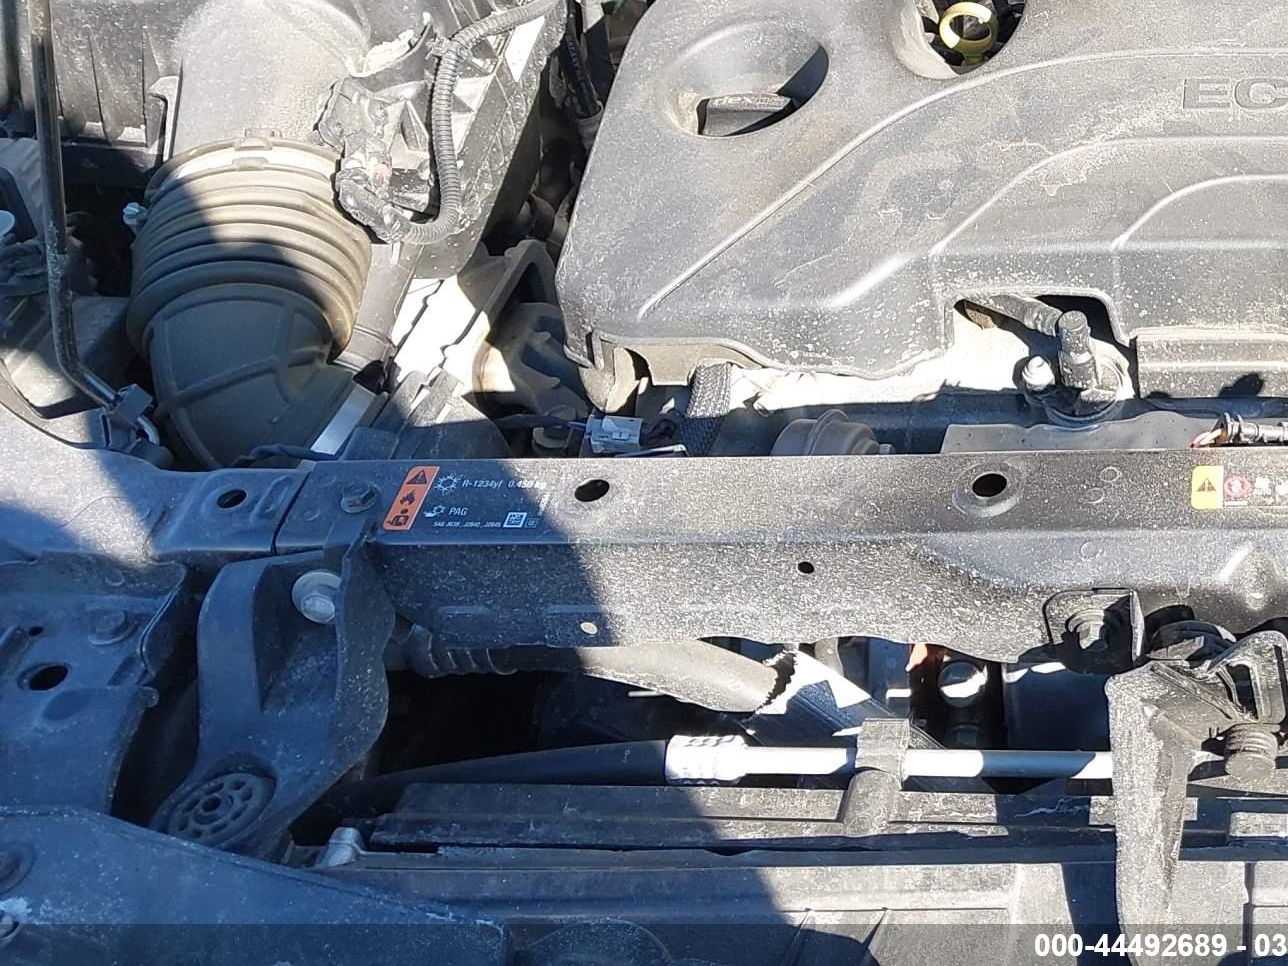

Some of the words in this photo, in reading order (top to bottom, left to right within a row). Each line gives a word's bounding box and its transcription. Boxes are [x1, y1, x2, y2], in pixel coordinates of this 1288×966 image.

[461, 479, 503, 490] R-1234yf
[507, 479, 534, 489] 0.450
[448, 507, 469, 516] PAG
